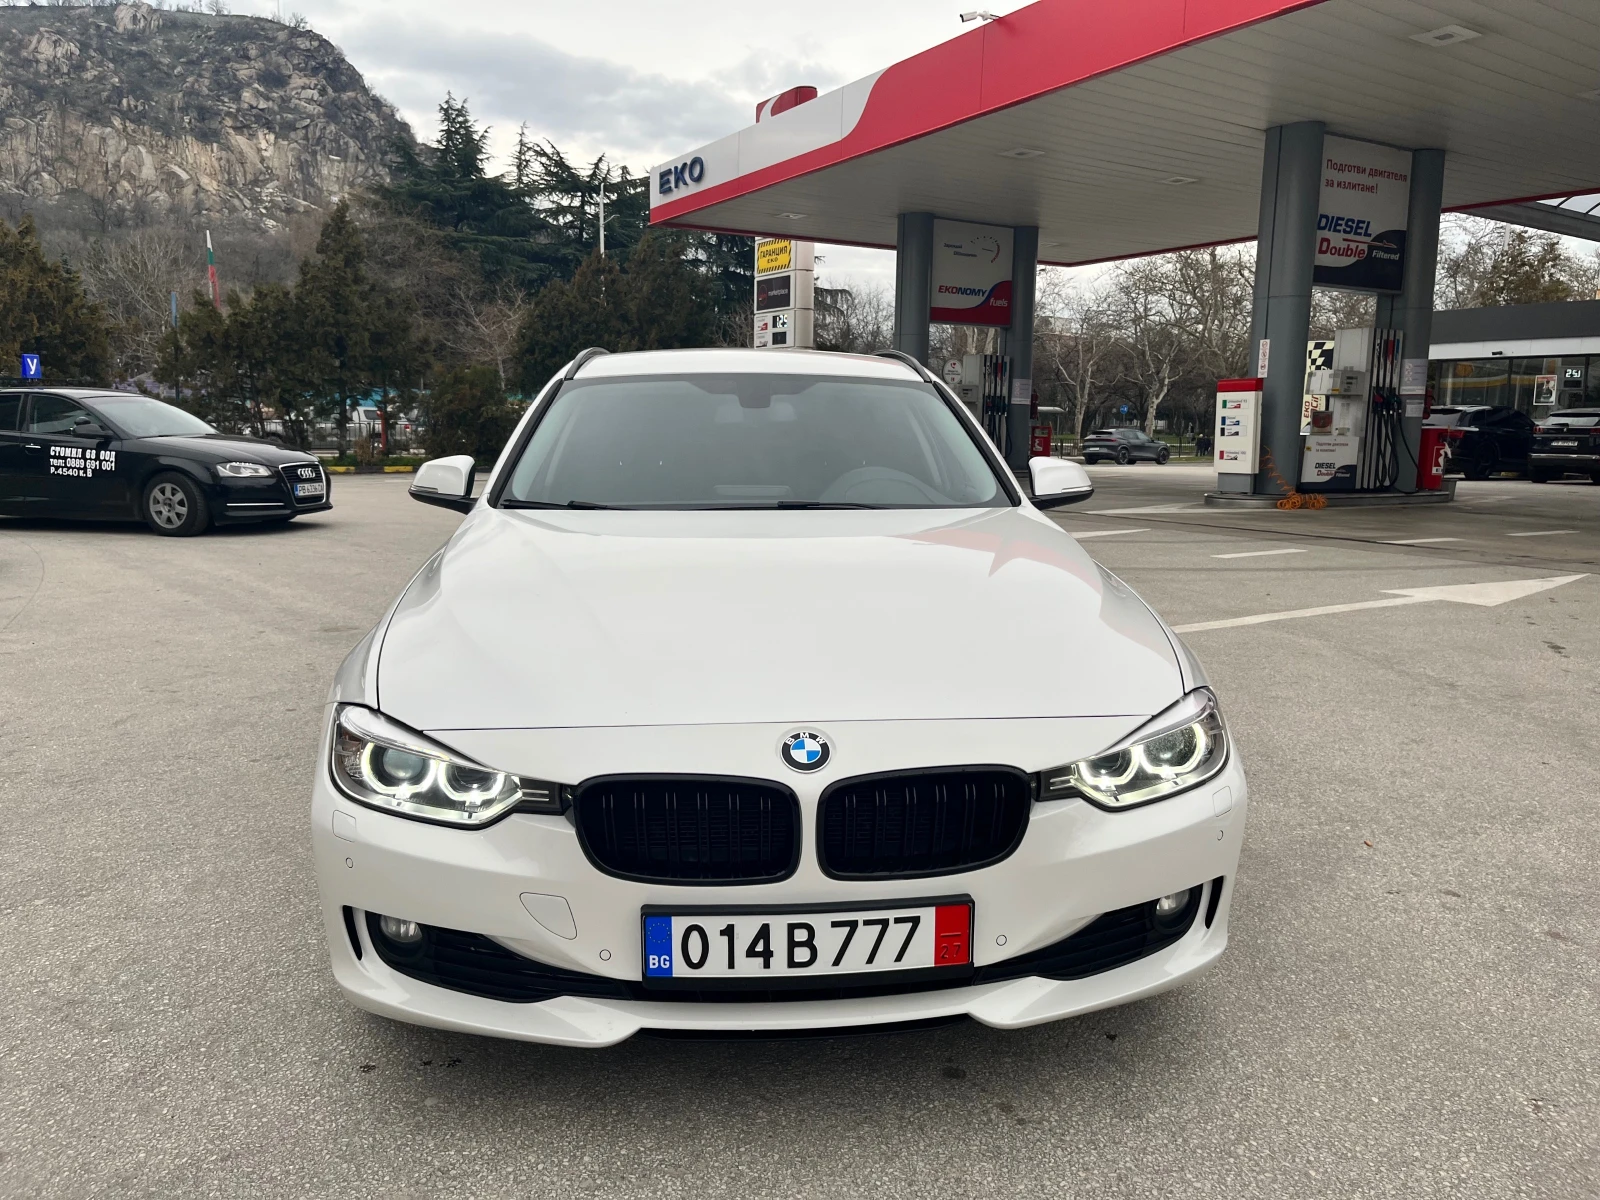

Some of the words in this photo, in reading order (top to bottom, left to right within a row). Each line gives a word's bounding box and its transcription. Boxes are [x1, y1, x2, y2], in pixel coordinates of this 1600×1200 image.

[659, 156, 704, 195] EKO
[1326, 159, 1367, 175] Подготви
[1368, 167, 1408, 183] двигателя
[1325, 178, 1335, 188] за
[1336, 181, 1379, 194] излитане!
[1317, 213, 1372, 238] DIESEL
[760, 245, 788, 260] ГАРАНЦИЯ
[1318, 237, 1366, 260] Double
[1372, 249, 1400, 260] Filtered
[938, 285, 988, 297] EKONOMY
[990, 298, 1008, 307] fuels
[1303, 401, 1311, 419] EKO
[86, 449, 96, 459] 68
[50, 458, 65, 467] тел:
[66, 458, 85, 468] 0889
[86, 459, 99, 470] 691
[101, 461, 115, 471] 001
[785, 731, 826, 745] BMW
[649, 955, 670, 969] BG
[939, 943, 961, 959] 27
